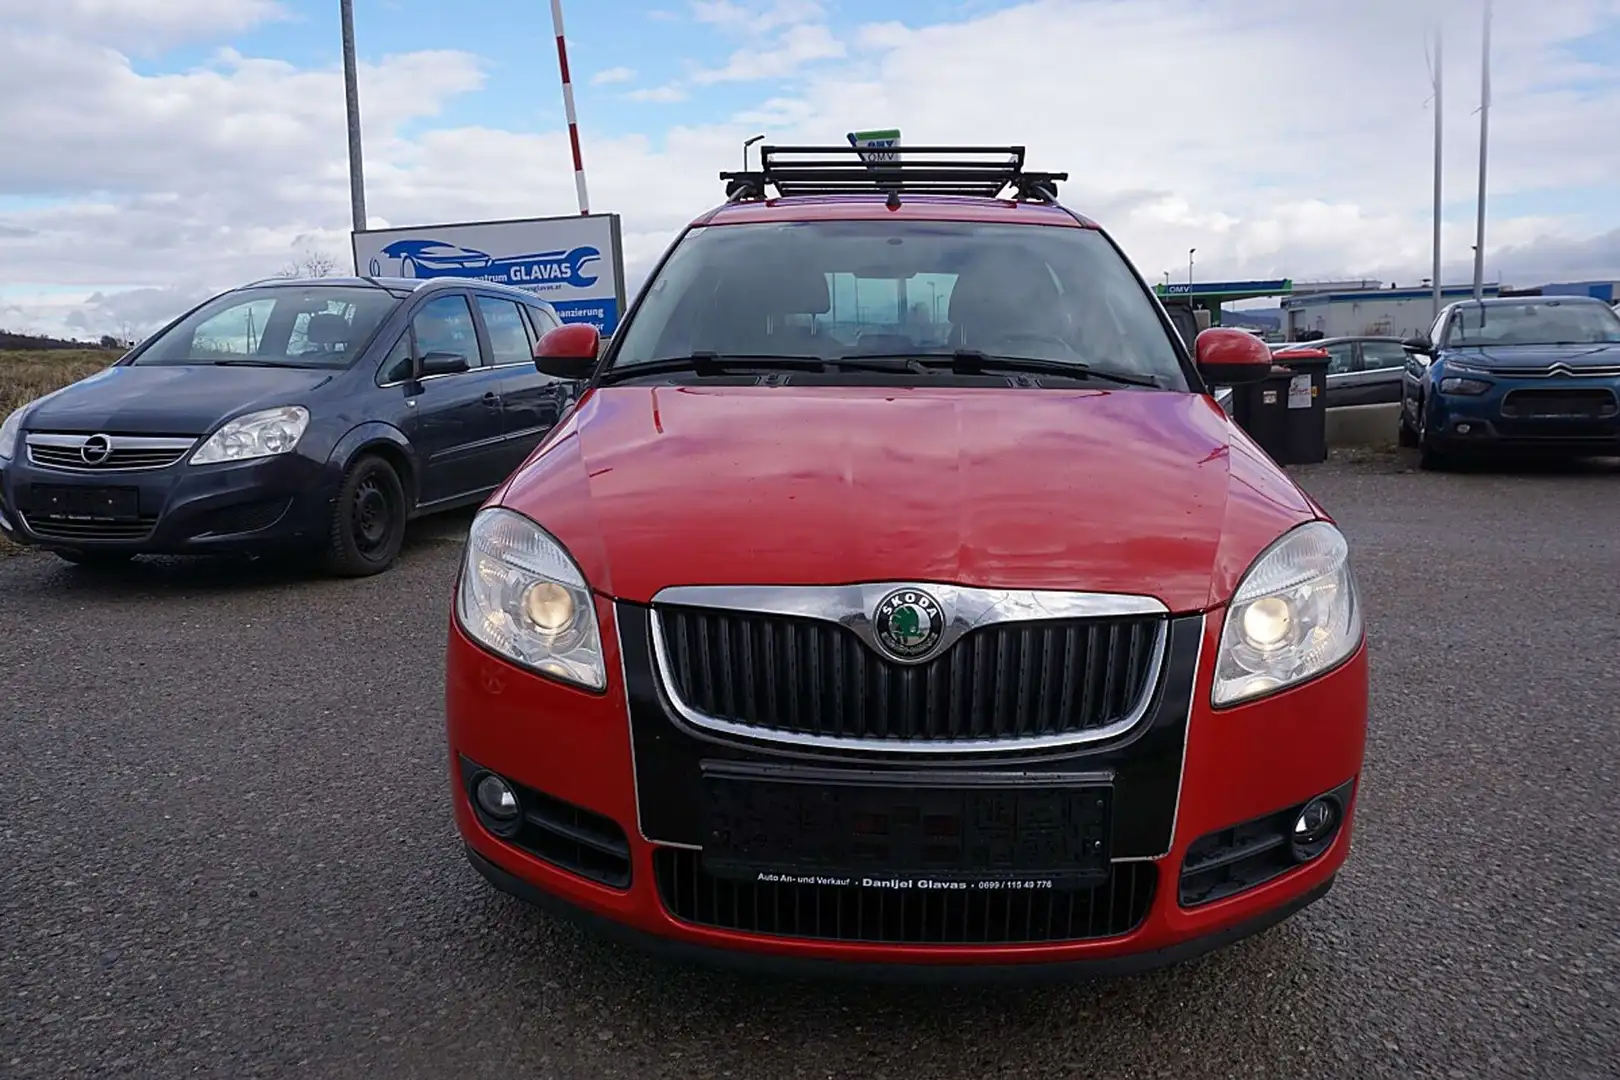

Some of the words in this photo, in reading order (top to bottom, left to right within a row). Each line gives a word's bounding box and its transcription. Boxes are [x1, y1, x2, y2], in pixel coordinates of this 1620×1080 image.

[510, 263, 572, 281] GLAVAS
[757, 872, 779, 882] Auto
[797, 876, 815, 884] und
[816, 876, 850, 886] Verkauf
[862, 878, 913, 889] Danijel
[917, 880, 967, 889] Glavas
